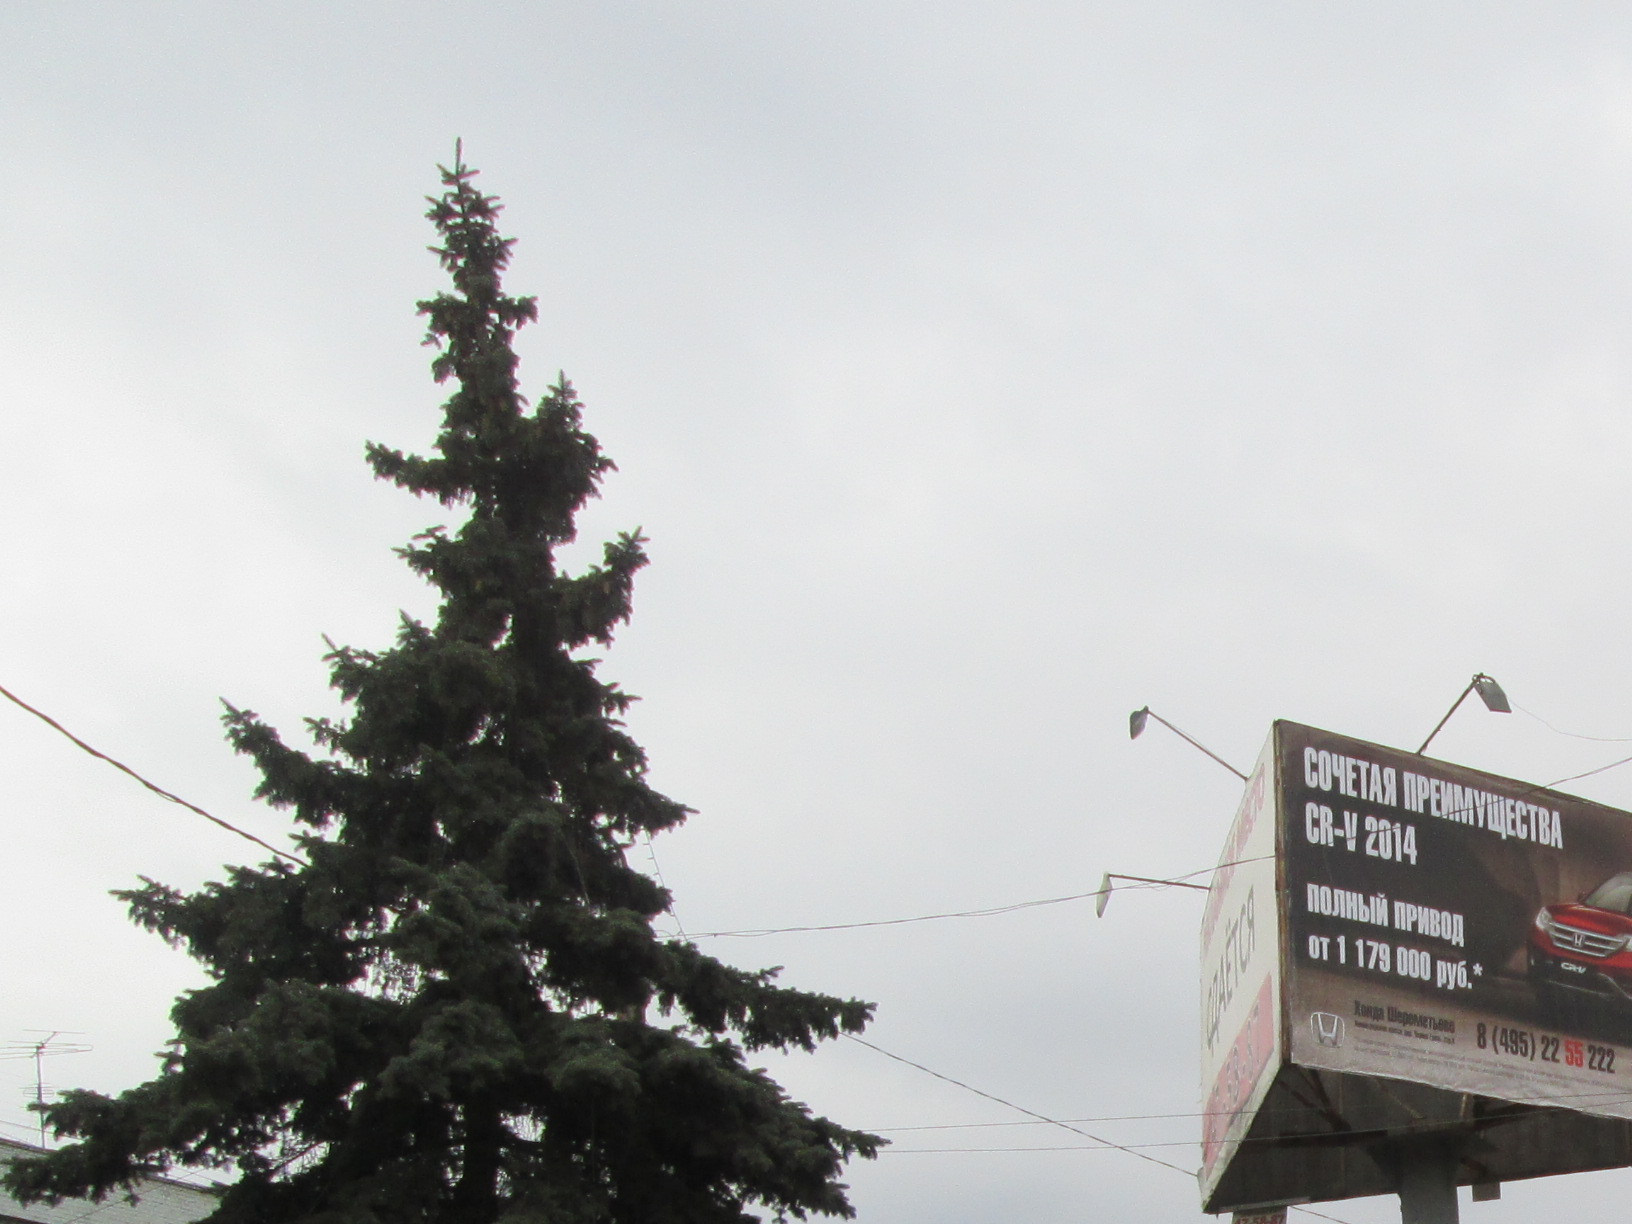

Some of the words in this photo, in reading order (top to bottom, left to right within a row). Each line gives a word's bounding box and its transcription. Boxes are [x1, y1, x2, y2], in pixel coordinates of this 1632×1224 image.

[1304, 747, 1398, 807] СОЧЕТАЯ
[1403, 771, 1564, 849] ПРЕИМУЩЕСТВА
[1305, 802, 1358, 852] CR-V
[1365, 816, 1418, 865] 2014
[1307, 882, 1389, 927] ПОЛНЫЙ
[1394, 900, 1465, 948] ПРИВОД
[1308, 935, 1330, 961] от
[1337, 935, 1346, 964] 1
[1355, 939, 1391, 973] 179
[1396, 946, 1431, 981] 000
[1476, 1022, 1487, 1050] 8
[1492, 1028, 1536, 1062] (495)
[1541, 1035, 1560, 1064] 22
[1565, 1039, 1585, 1068] 55
[1588, 1045, 1616, 1074] 222
